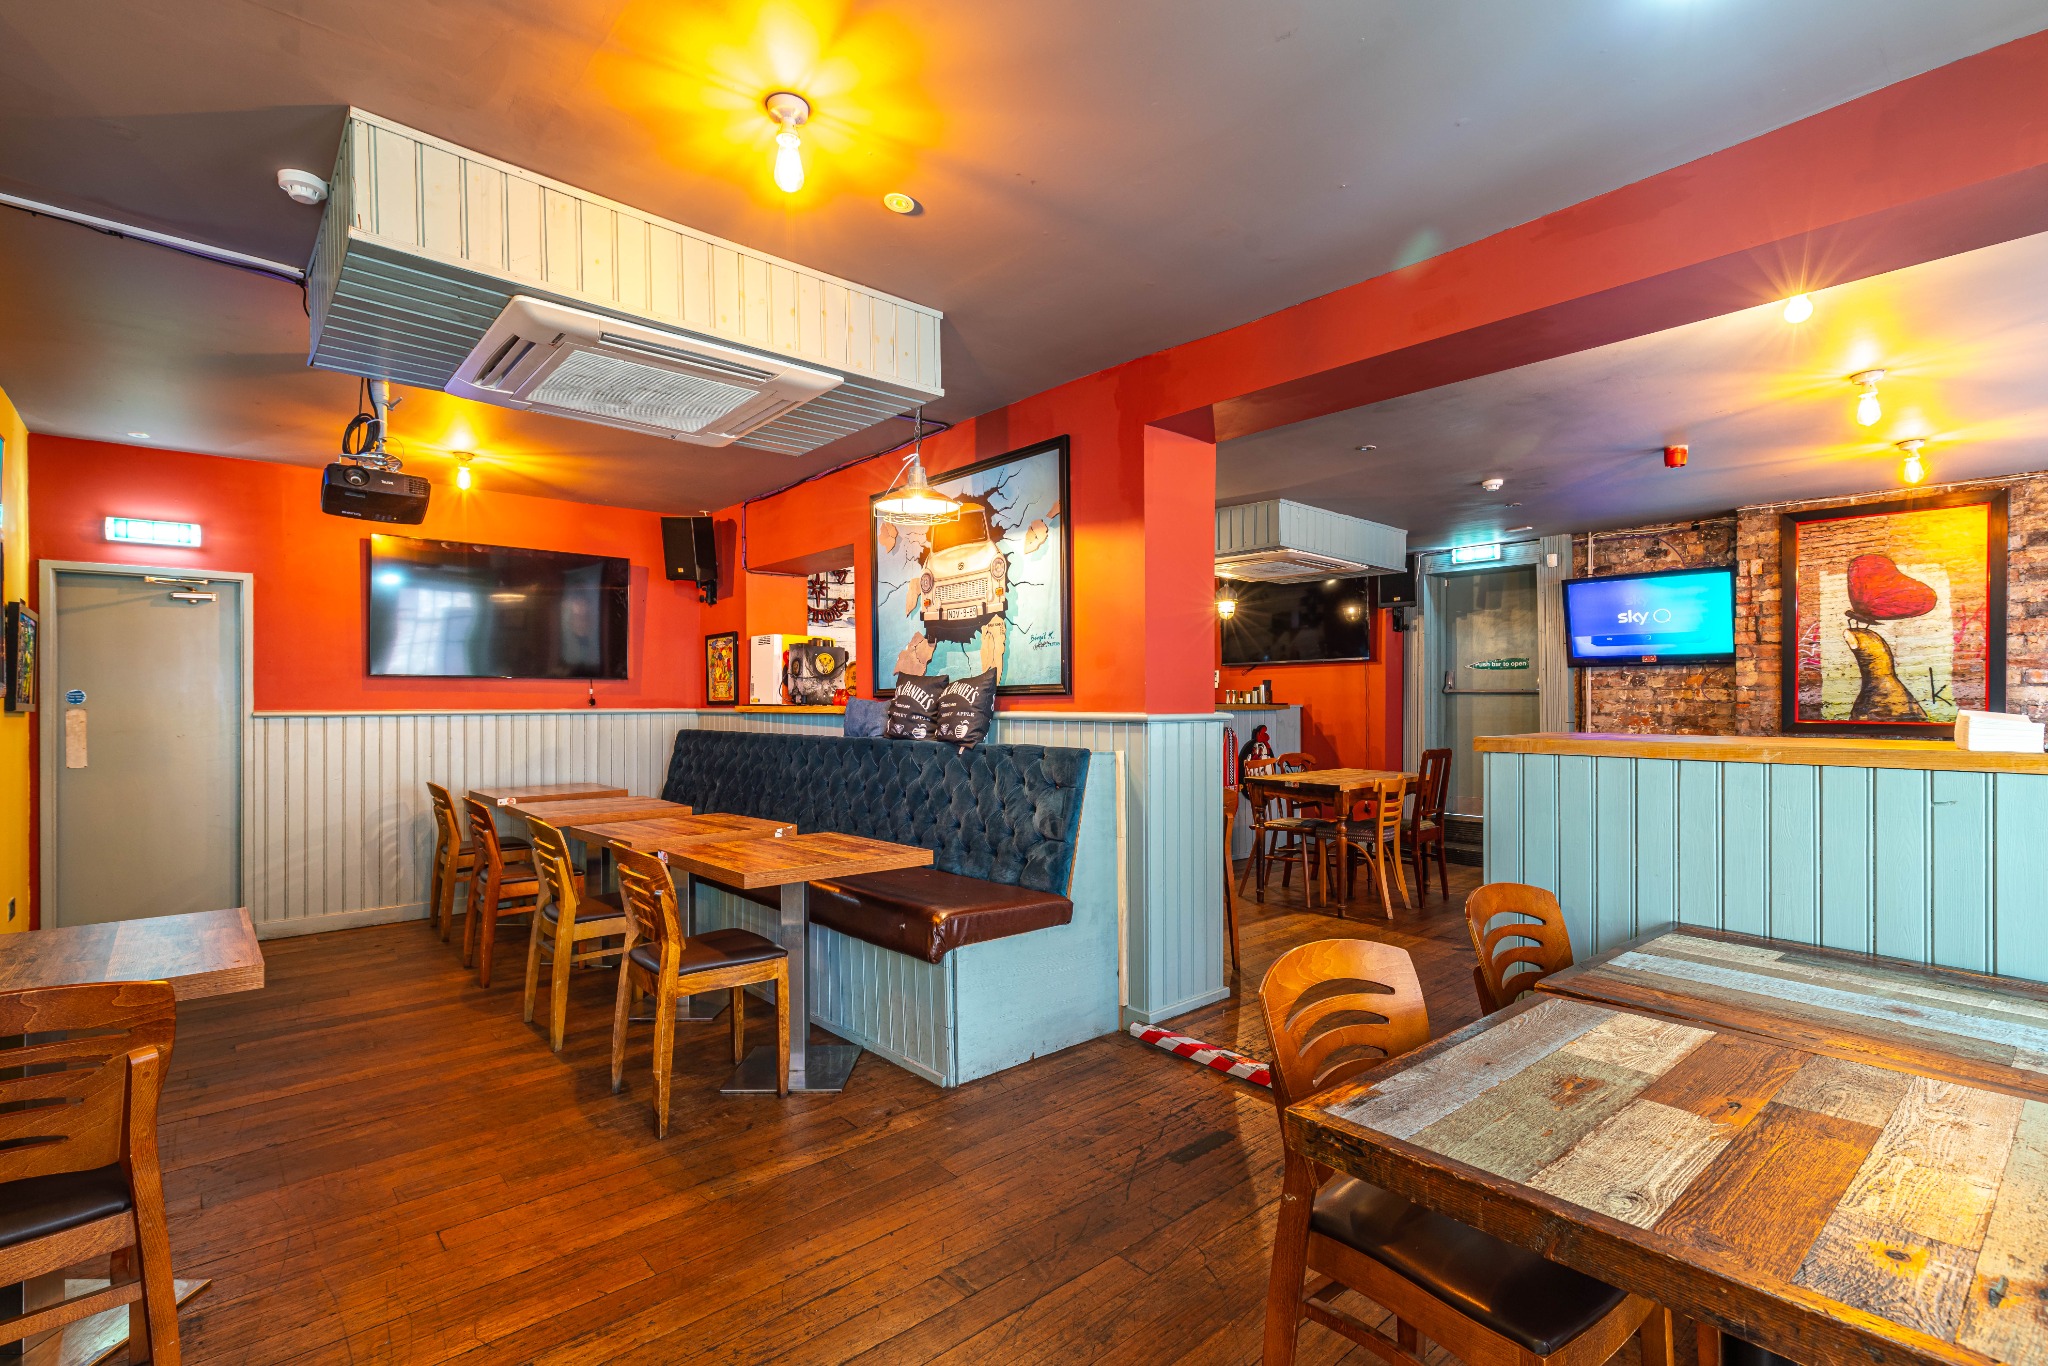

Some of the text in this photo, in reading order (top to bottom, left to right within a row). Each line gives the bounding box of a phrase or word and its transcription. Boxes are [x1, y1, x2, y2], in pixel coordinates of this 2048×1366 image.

[1617, 610, 1649, 625] sky
[902, 680, 935, 711] DANIEL'S
[947, 681, 979, 705] DANIEL'S
